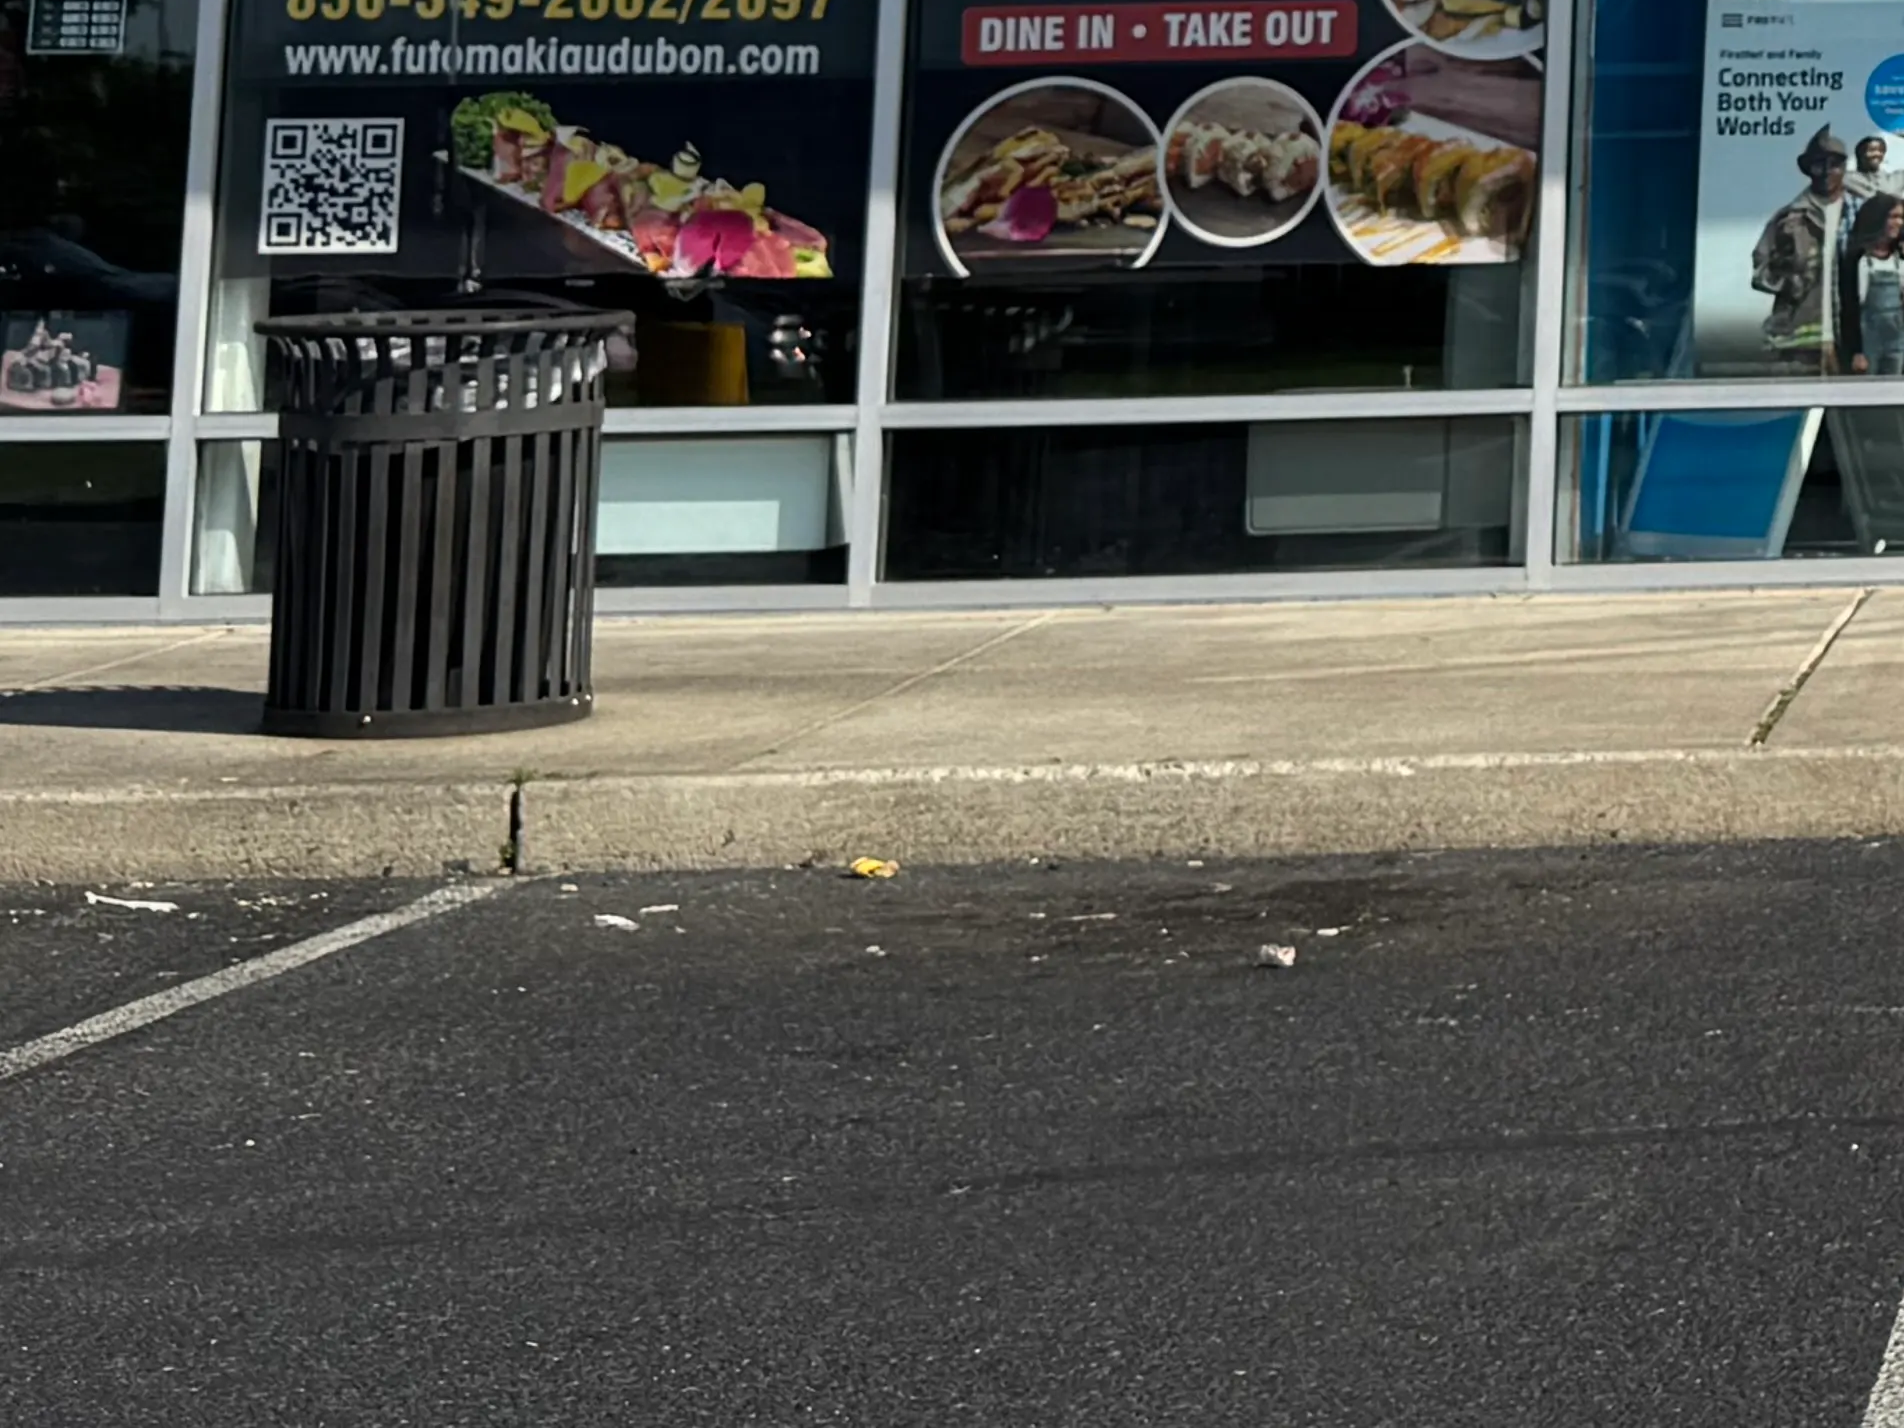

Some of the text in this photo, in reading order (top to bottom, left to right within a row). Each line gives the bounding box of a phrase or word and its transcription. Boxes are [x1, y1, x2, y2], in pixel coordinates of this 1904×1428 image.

[979, 10, 1338, 52] DINE IN TAKE OUT
[285, 36, 819, 77] www.futomakiaudubon.com
[1718, 66, 1844, 91] Connecting
[1717, 91, 1829, 112] Both Your
[1716, 115, 1796, 136] Worlds
